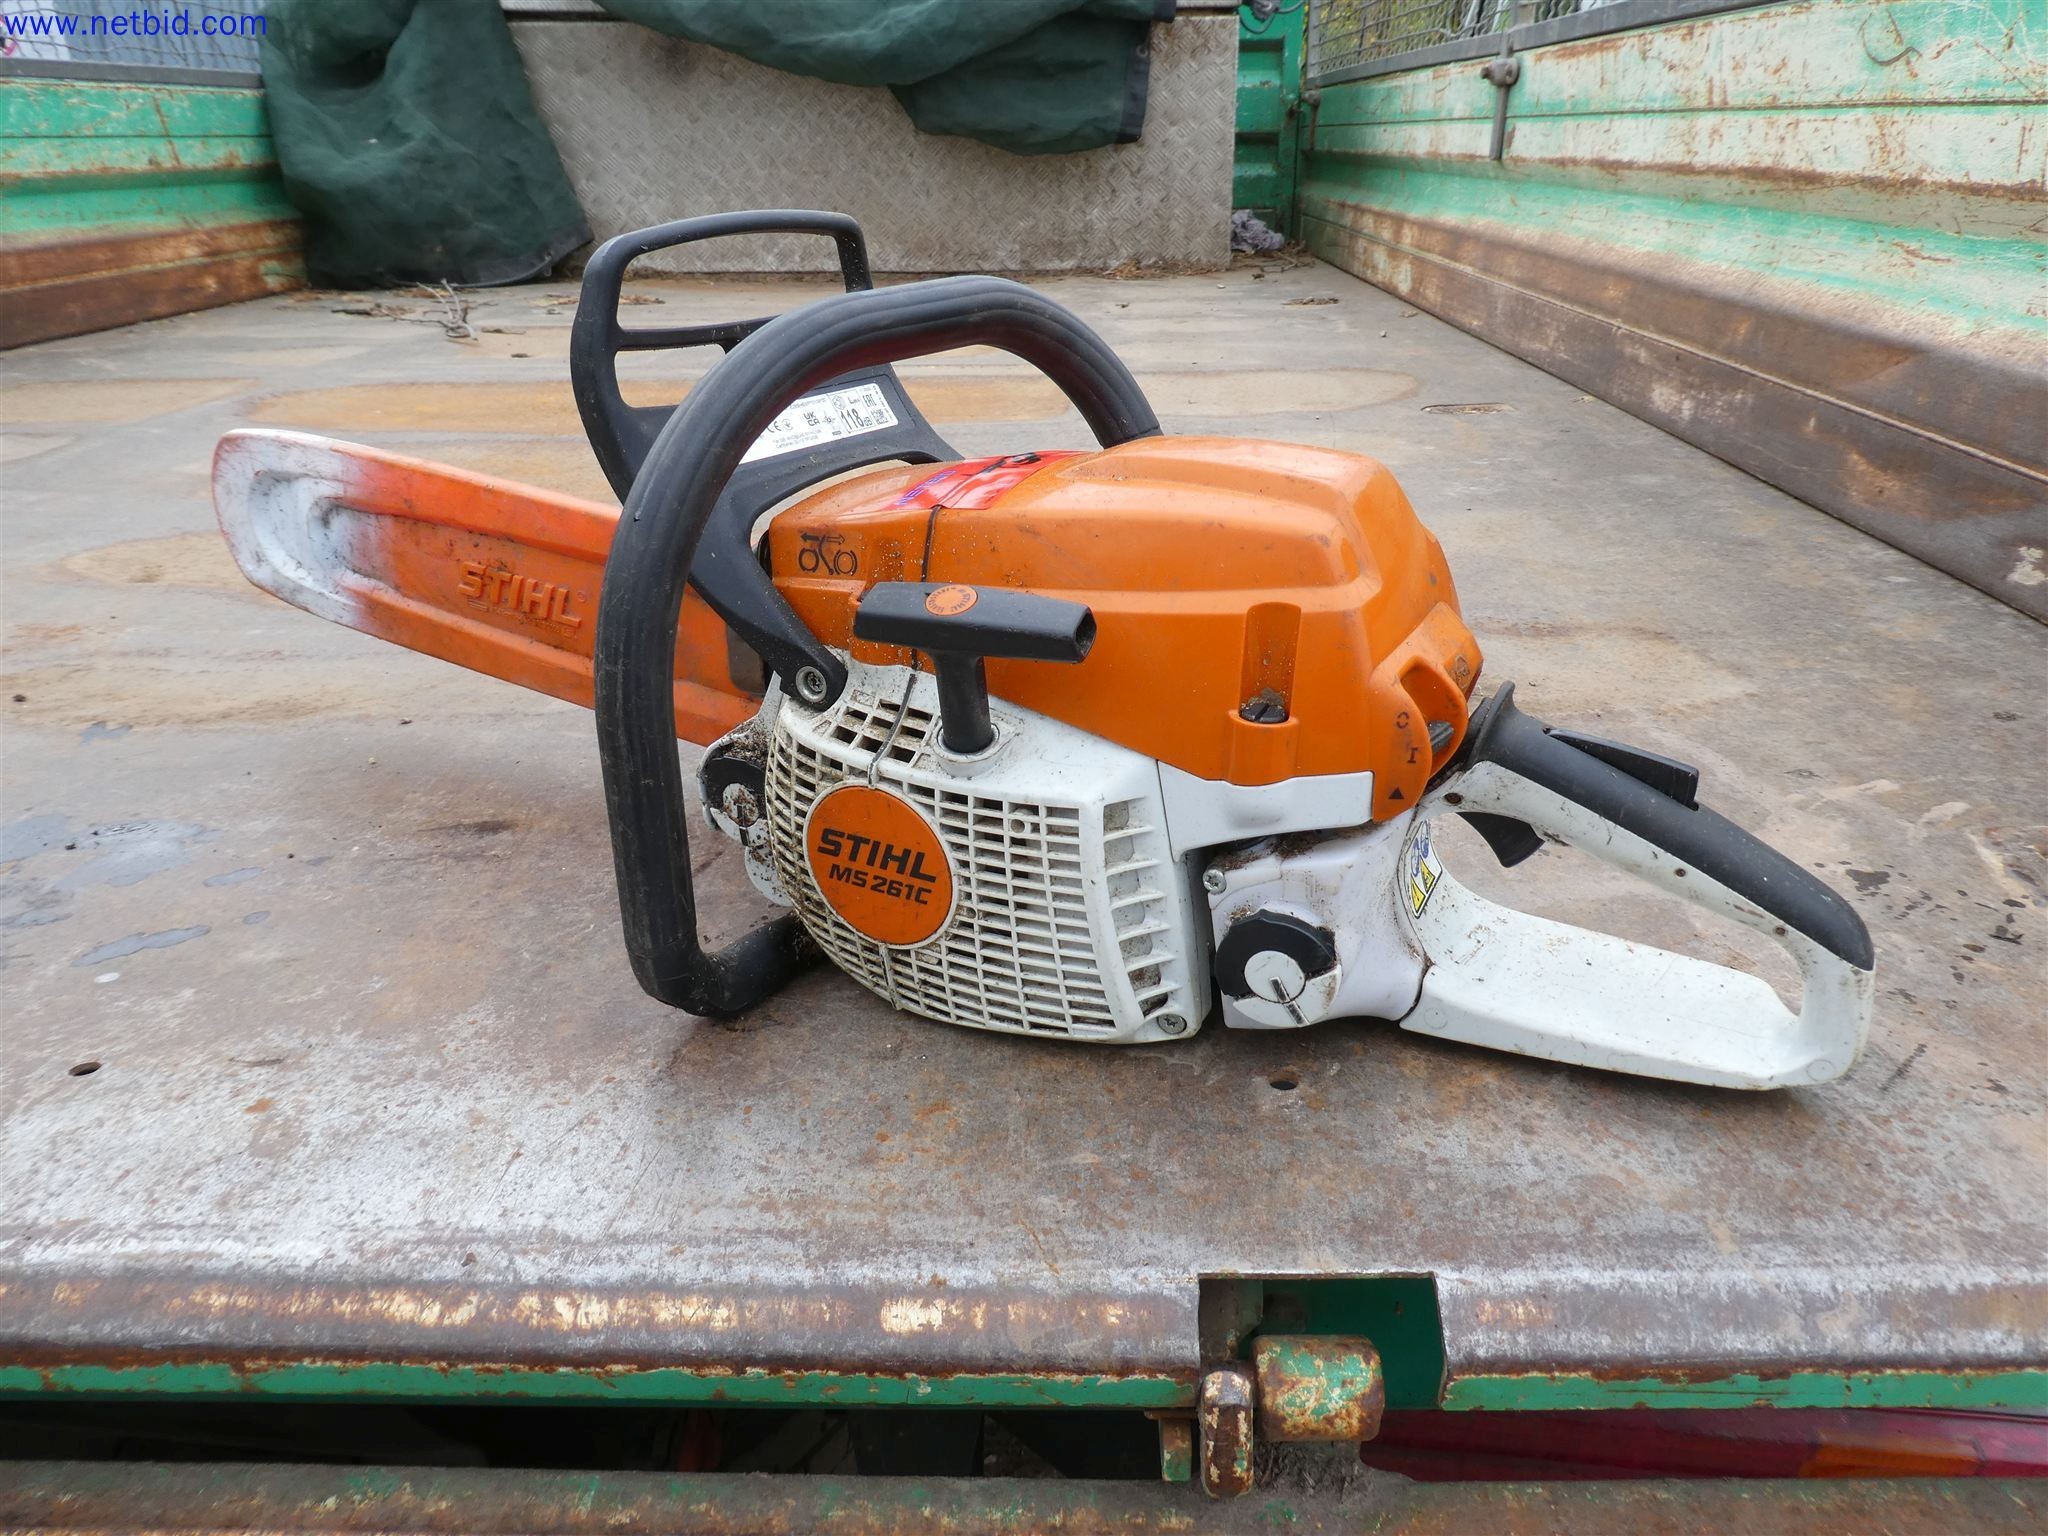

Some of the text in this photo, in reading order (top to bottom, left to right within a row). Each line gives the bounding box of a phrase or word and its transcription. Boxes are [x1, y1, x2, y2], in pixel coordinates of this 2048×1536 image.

[803, 411, 816, 420] UK
[840, 408, 864, 430] 118
[457, 561, 582, 628] STIHL
[817, 828, 937, 883] STIHL
[828, 863, 932, 905] MS 261C
